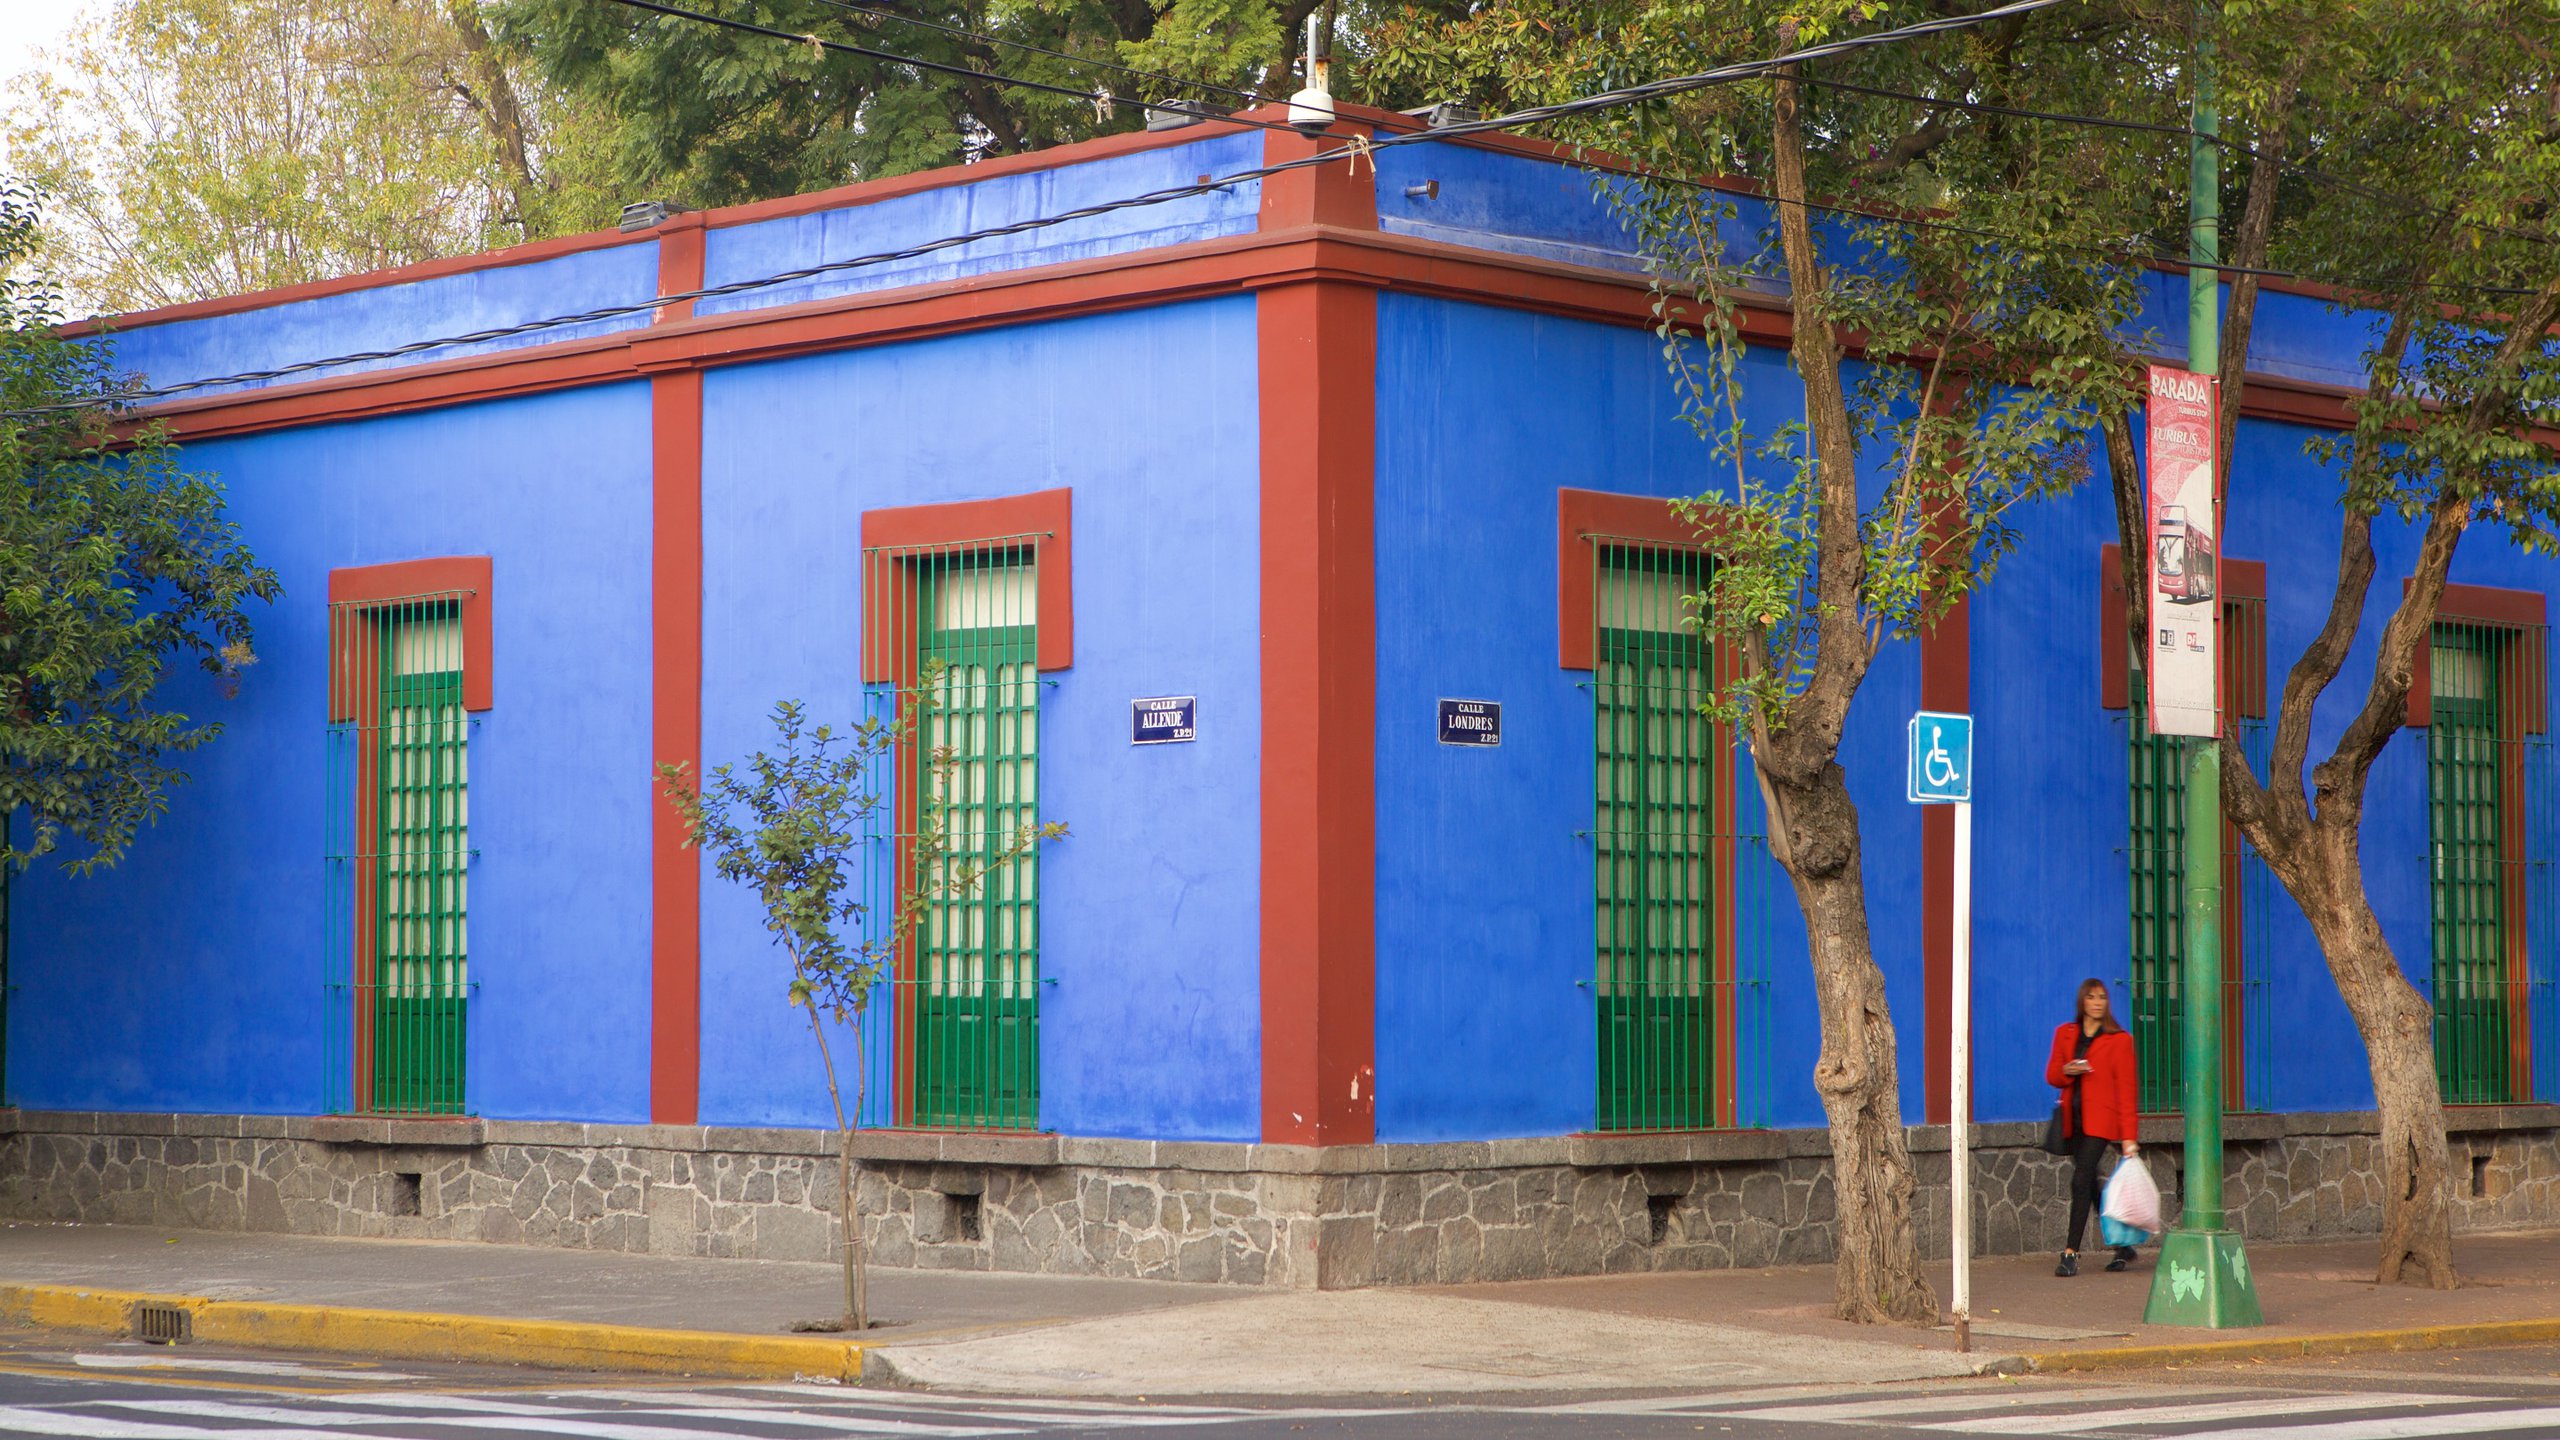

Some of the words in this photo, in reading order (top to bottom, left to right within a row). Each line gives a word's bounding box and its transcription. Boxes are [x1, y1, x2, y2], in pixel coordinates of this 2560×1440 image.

[2151, 374, 2207, 404] PARADA
[2152, 427, 2198, 446] TURIBUS
[1151, 701, 1176, 710] CALLE
[1458, 704, 1484, 713] CALLE
[1142, 711, 1183, 728] ALLENDE
[1448, 715, 1493, 730] LONDRES
